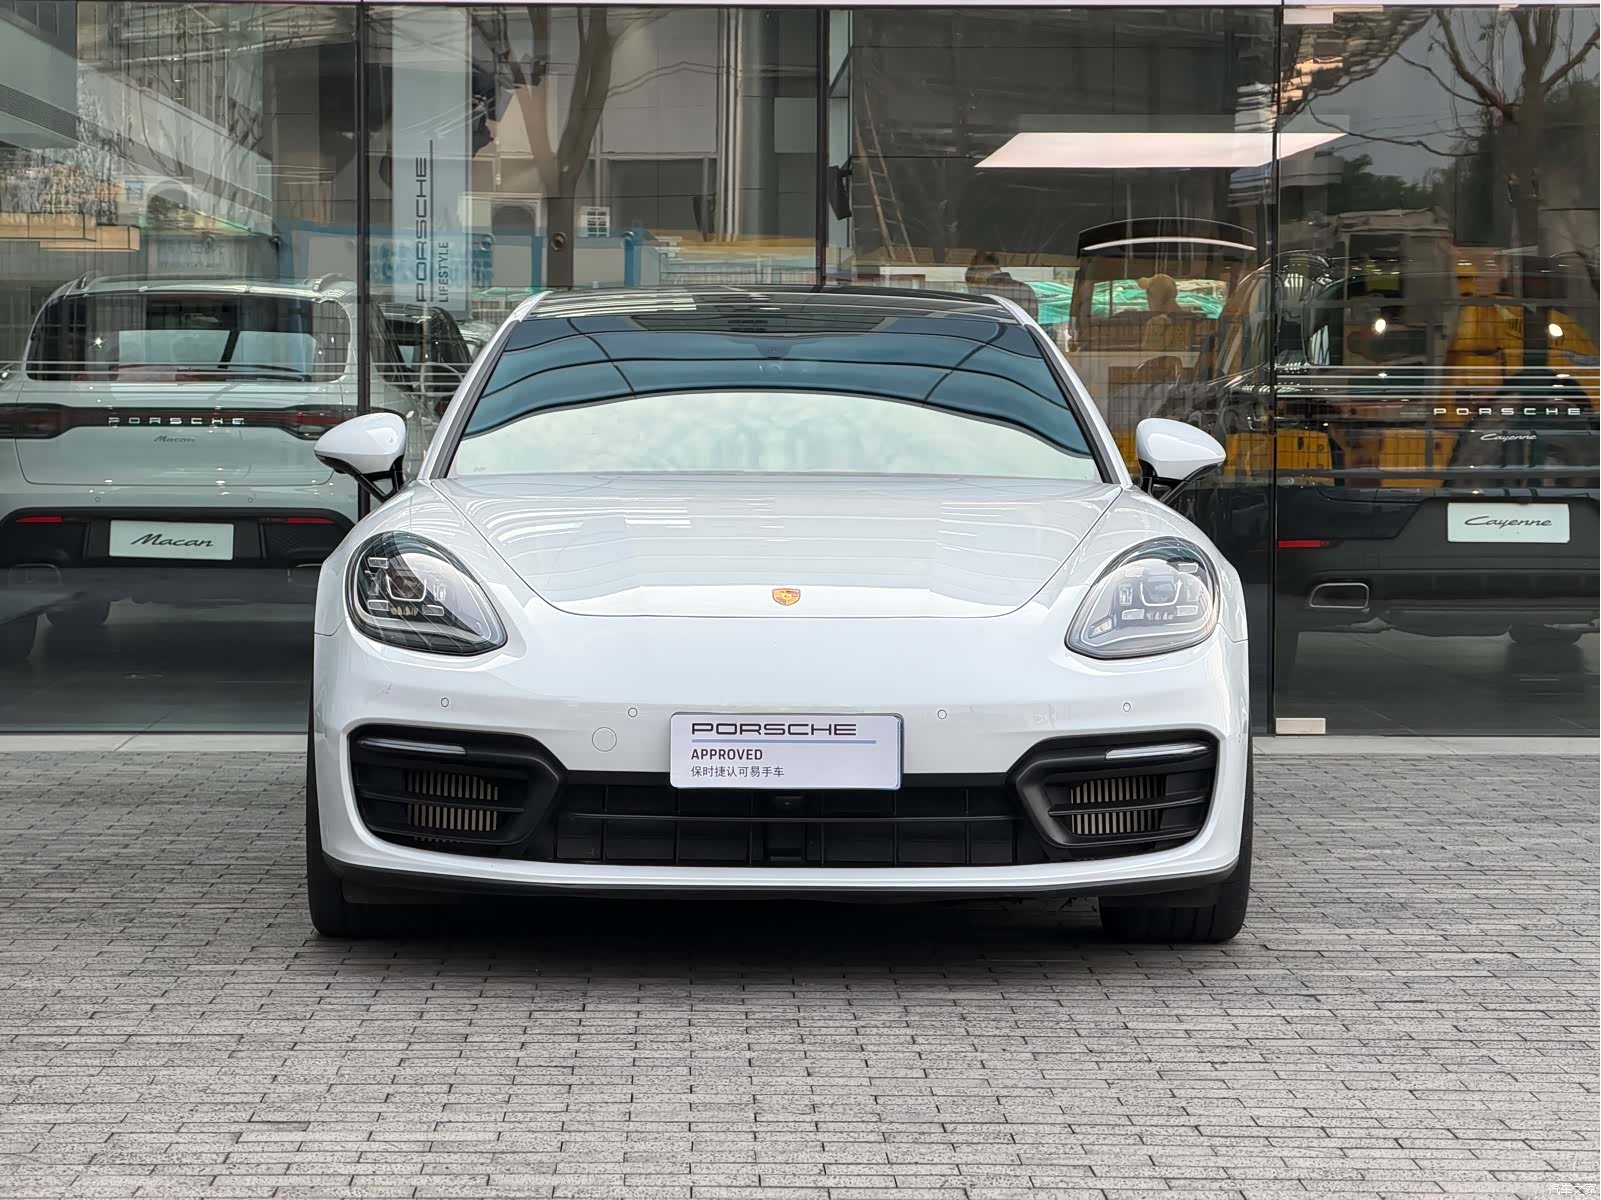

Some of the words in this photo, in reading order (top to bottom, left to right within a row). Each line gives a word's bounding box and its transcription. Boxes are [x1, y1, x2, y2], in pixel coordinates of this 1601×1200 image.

[415, 157, 428, 303] PORSCHE
[438, 241, 449, 303] LIFESTYLE
[1433, 407, 1581, 416] PORSCHE
[108, 416, 245, 425] PORSCHE
[153, 435, 197, 443] Macan
[1480, 433, 1538, 443] Cayenne
[1464, 515, 1553, 530] Cayenne
[130, 533, 214, 547] Macan
[691, 722, 857, 736] PORSCHE
[690, 748, 764, 761] APPROVED
[690, 765, 785, 778] 保时捷认可易手车
